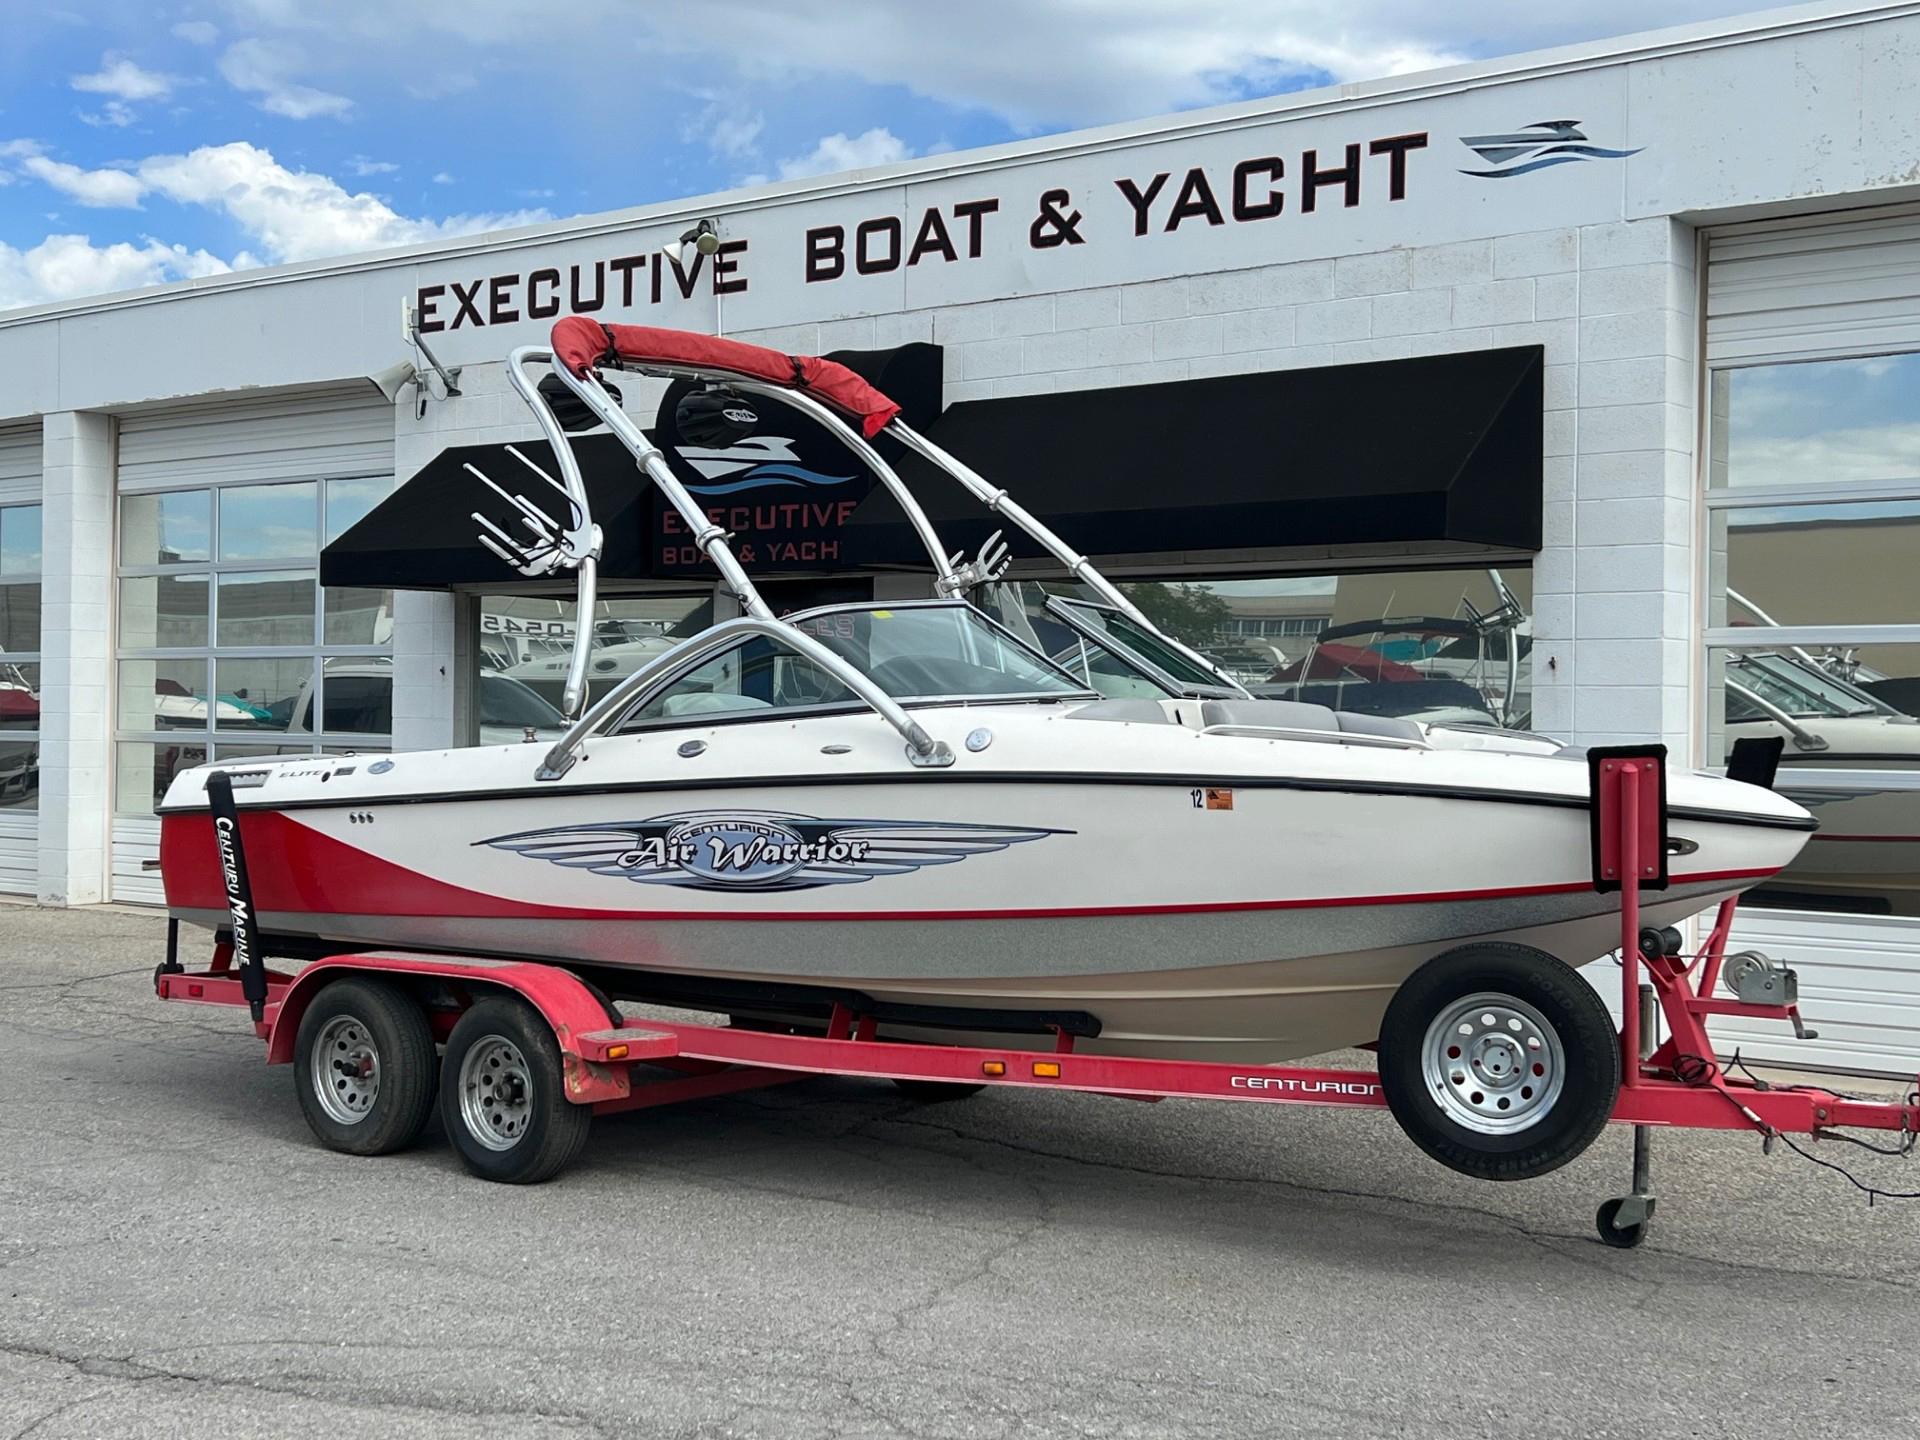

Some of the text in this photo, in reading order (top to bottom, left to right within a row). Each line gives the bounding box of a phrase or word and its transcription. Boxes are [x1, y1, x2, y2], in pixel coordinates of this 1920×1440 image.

[418, 132, 1428, 333] EXECUTIVE BOAT & YACHT
[663, 501, 857, 534] EECUTIVE
[663, 540, 840, 565] BOA & YACH
[1190, 789, 1203, 808] 12
[680, 823, 785, 842] CENTURION
[616, 835, 870, 872] Air Warrior
